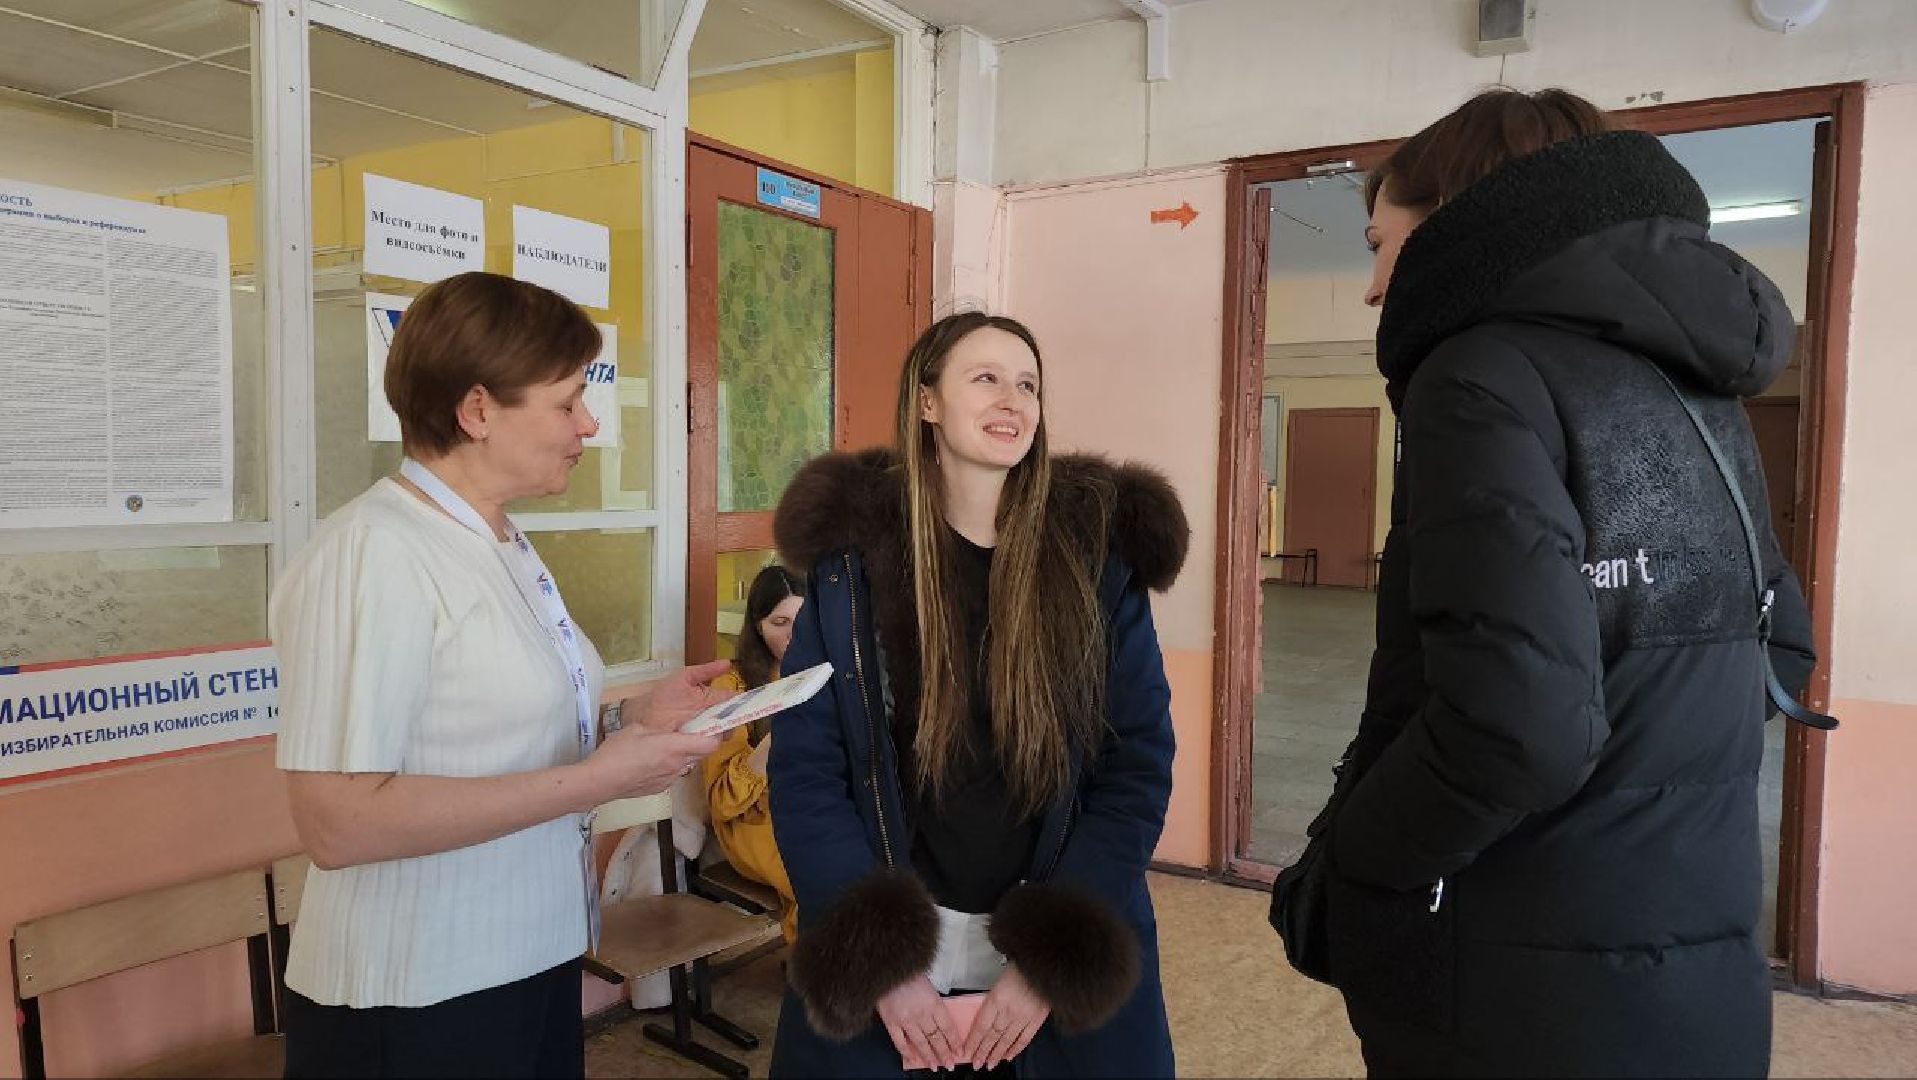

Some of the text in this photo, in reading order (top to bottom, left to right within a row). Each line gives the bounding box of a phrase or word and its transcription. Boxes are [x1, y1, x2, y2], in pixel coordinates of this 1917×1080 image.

[371, 210, 478, 243] Место для фото и
[517, 243, 607, 272] НАБЛЮДАТЕЛИ
[208, 667, 278, 696] СТЕН
[1, 722, 149, 757] ИЗБИРАТЕЛЬНАЯ
[154, 709, 239, 733] КОМИССИЯ
